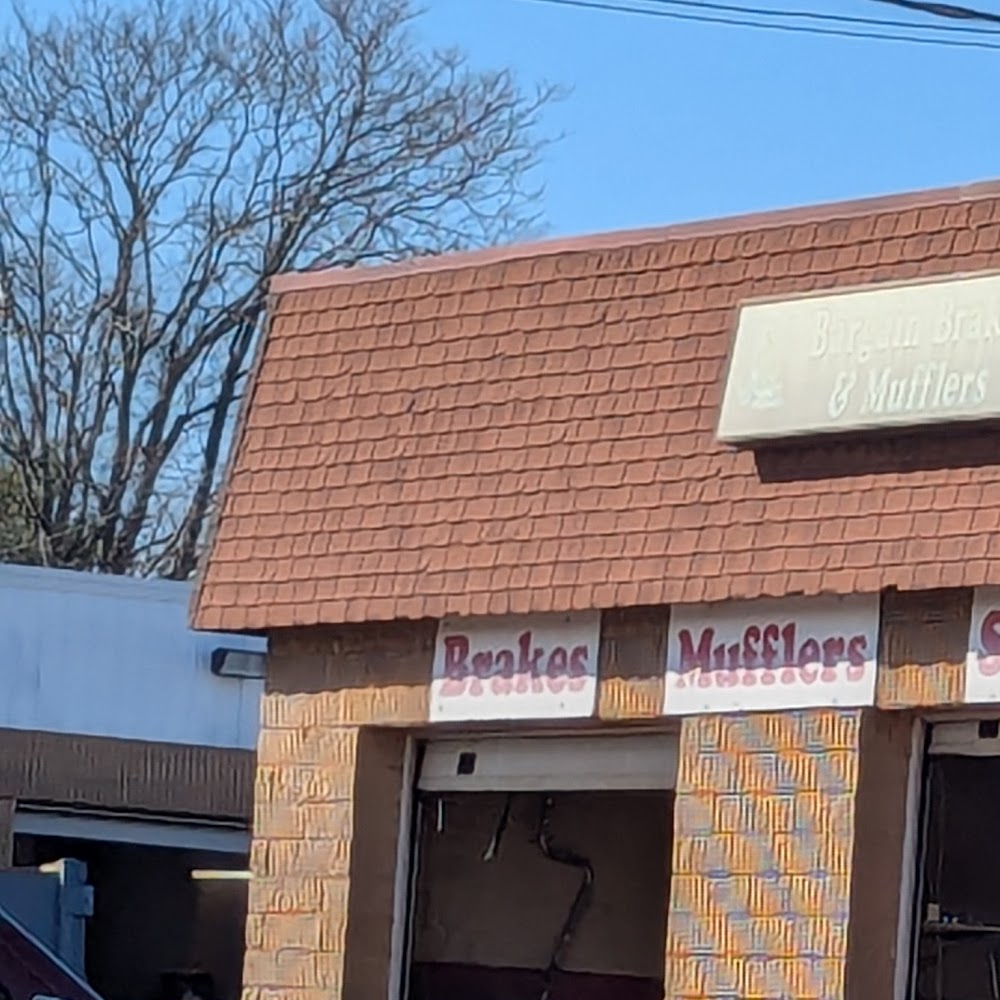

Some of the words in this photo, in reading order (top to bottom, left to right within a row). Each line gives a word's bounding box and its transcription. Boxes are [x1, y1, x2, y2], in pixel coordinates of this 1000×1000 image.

[810, 310, 920, 360] Bargain
[827, 371, 853, 418] &
[865, 364, 989, 412] Mufflers
[439, 632, 588, 696] Brakes
[677, 624, 867, 688] Mufflers
